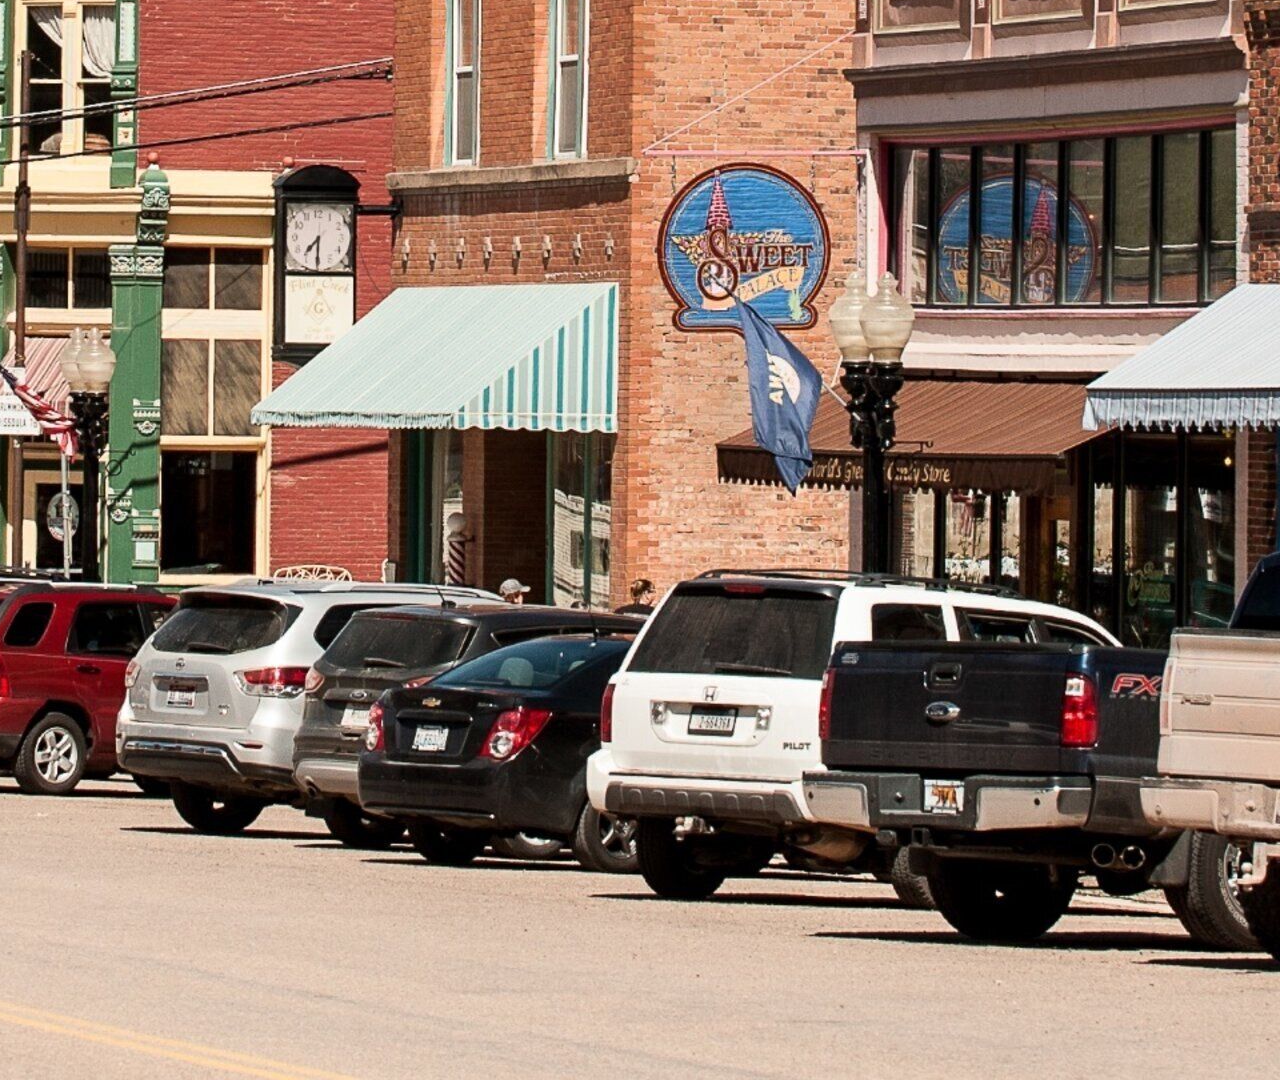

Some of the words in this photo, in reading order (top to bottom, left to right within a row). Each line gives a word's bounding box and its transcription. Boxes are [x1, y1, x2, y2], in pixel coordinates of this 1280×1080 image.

[763, 229, 793, 243] The
[697, 229, 814, 300] SWEET
[921, 463, 951, 482] Store
[1111, 673, 1162, 696] FX
[783, 742, 812, 750] PILOT
